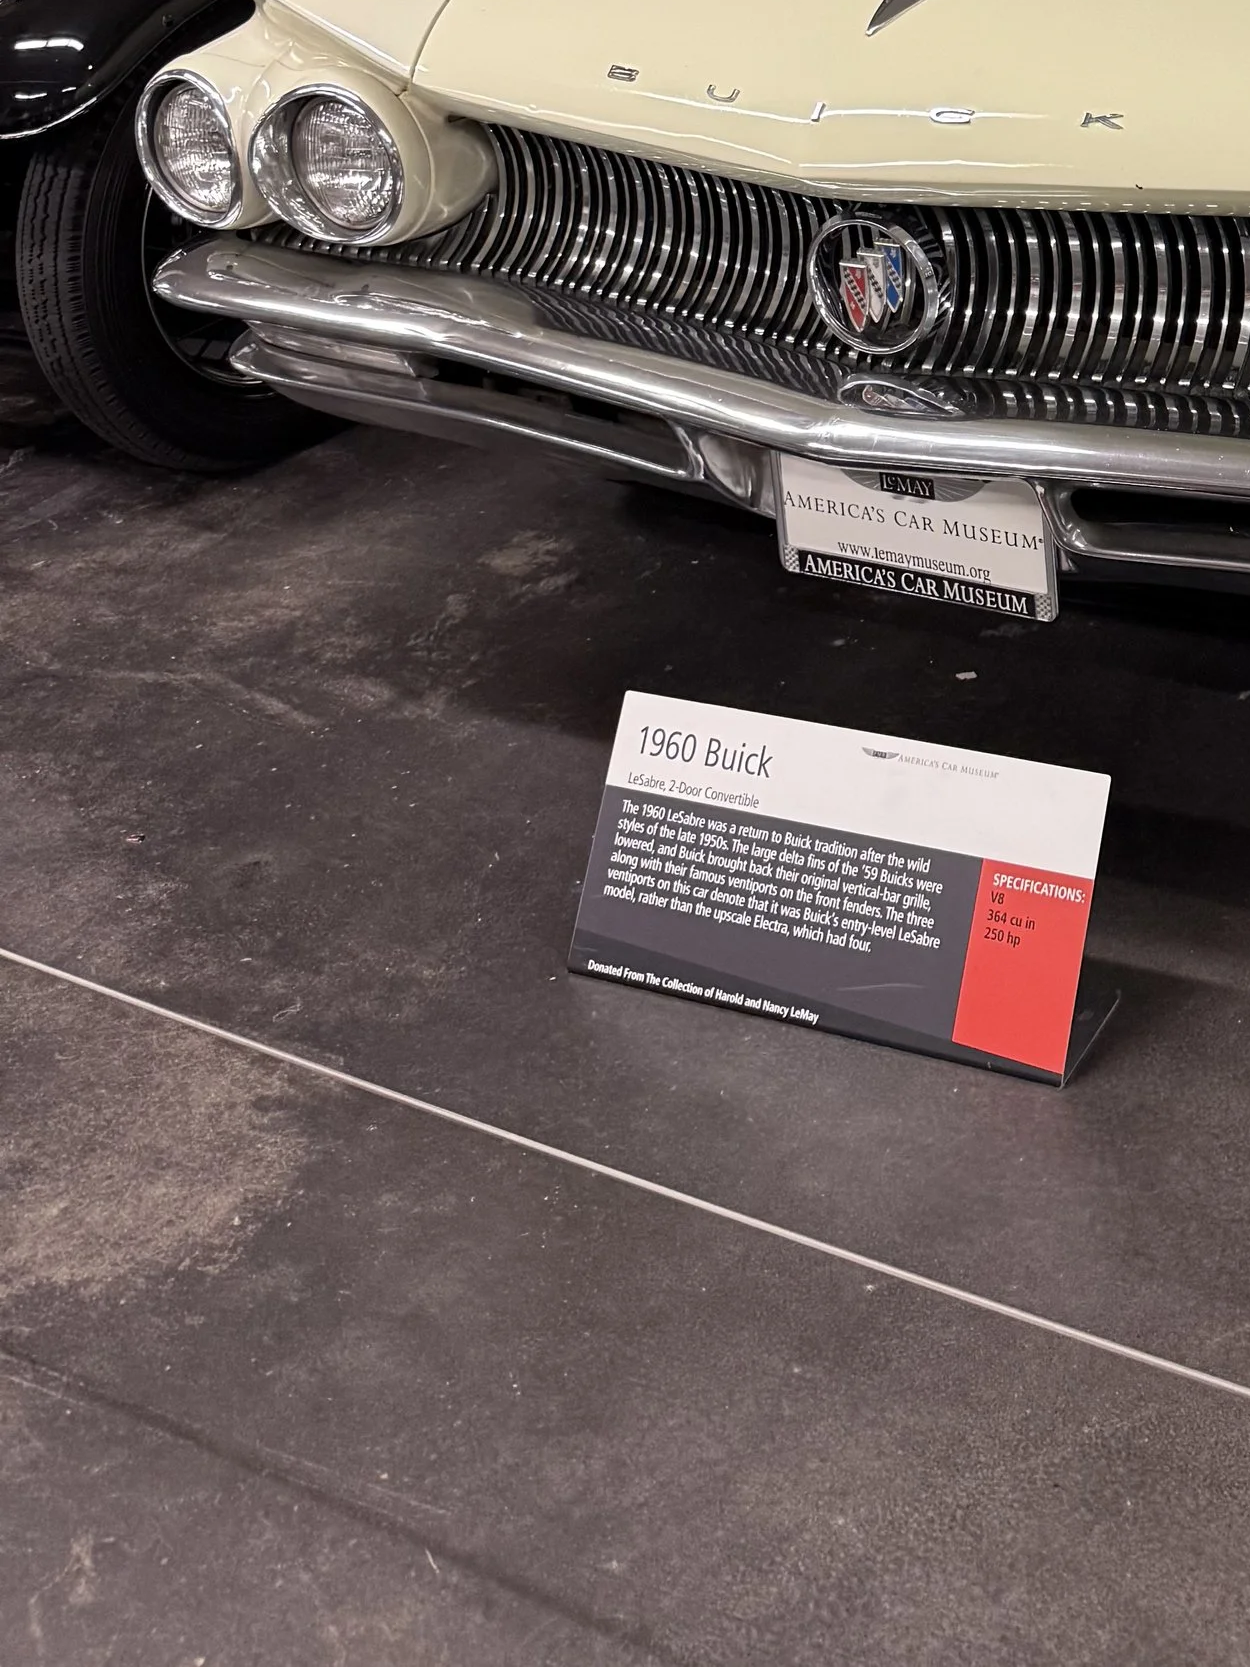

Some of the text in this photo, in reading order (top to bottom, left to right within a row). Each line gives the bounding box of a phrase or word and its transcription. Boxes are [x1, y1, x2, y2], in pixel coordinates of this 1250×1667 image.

[607, 63, 1125, 130] BUICK
[784, 490, 885, 524] AMERICA'S
[894, 510, 934, 533] CAR
[804, 554, 1029, 615] AMERICA'S CAR MUSEUM
[838, 541, 990, 583] www.lemaymuseum.org
[640, 725, 773, 778] 1960 Buick
[627, 771, 759, 809] LeSabre, 2-Door Convertible
[617, 817, 943, 894] styles of the late 1950s. The large delta fins of the '59 Buicks were
[622, 799, 931, 873] The 1960 LeSabre was a return to Buick tradition after the wild
[610, 849, 934, 929] along with their famous ventiports on the front fenders. The three
[613, 831, 931, 912] lowered, and Buick brought back their original vertical-bar grille,
[991, 890, 1005, 905] V8
[992, 873, 1085, 903] SPECIFICATIONS:
[603, 884, 871, 953] model, rather than the upscale Electra, which had four.
[607, 868, 940, 949] ventiports on this car denote that it was Buick's entry-level LeSabre
[983, 926, 1021, 948] 250 hp
[986, 908, 1035, 930] 364 cu in
[587, 959, 819, 1025] Donated From The Collection of Harold and Nancy LeMay
